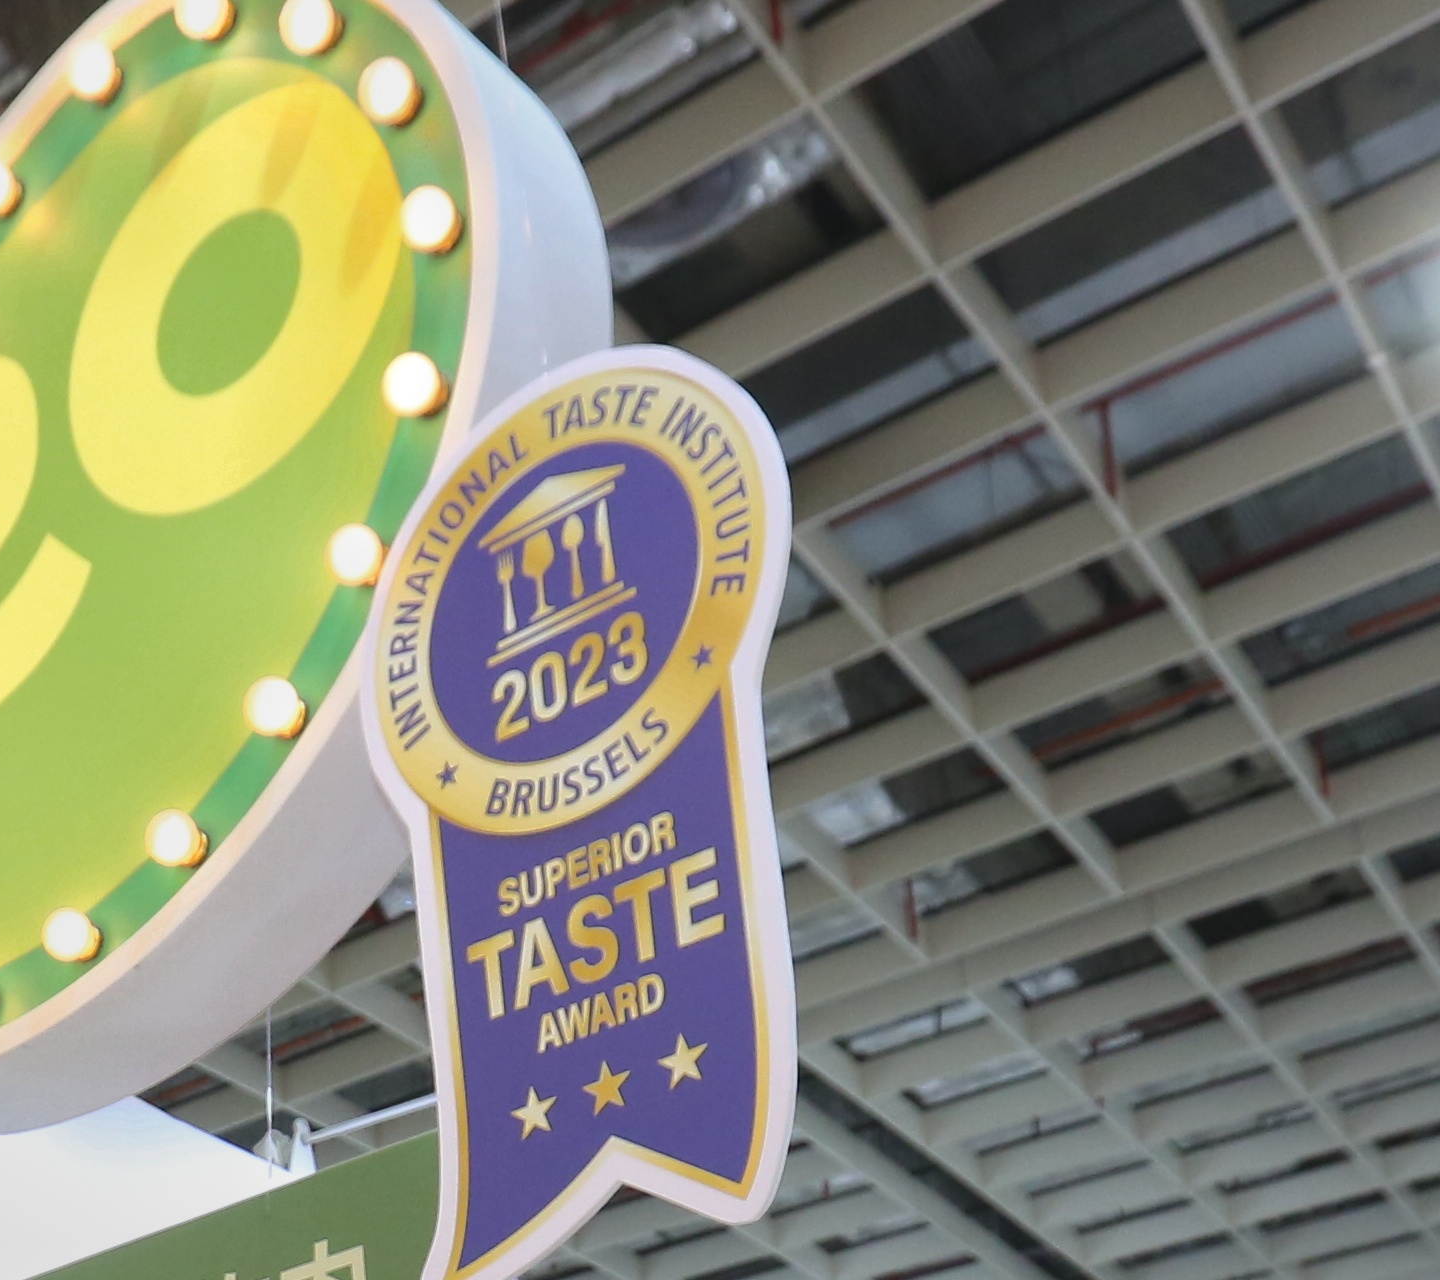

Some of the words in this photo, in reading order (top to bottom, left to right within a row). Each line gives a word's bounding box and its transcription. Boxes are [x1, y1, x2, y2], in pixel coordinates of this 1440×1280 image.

[388, 445, 529, 747] INTERNATIONAL
[542, 384, 655, 440] TASTE
[663, 394, 747, 599] INSTITUTE
[491, 617, 649, 743] 2023
[484, 708, 673, 819] BRUSSELS
[497, 812, 677, 917] SUPERIOR
[465, 846, 725, 1021] TASTE
[536, 973, 667, 1054] AWARD
